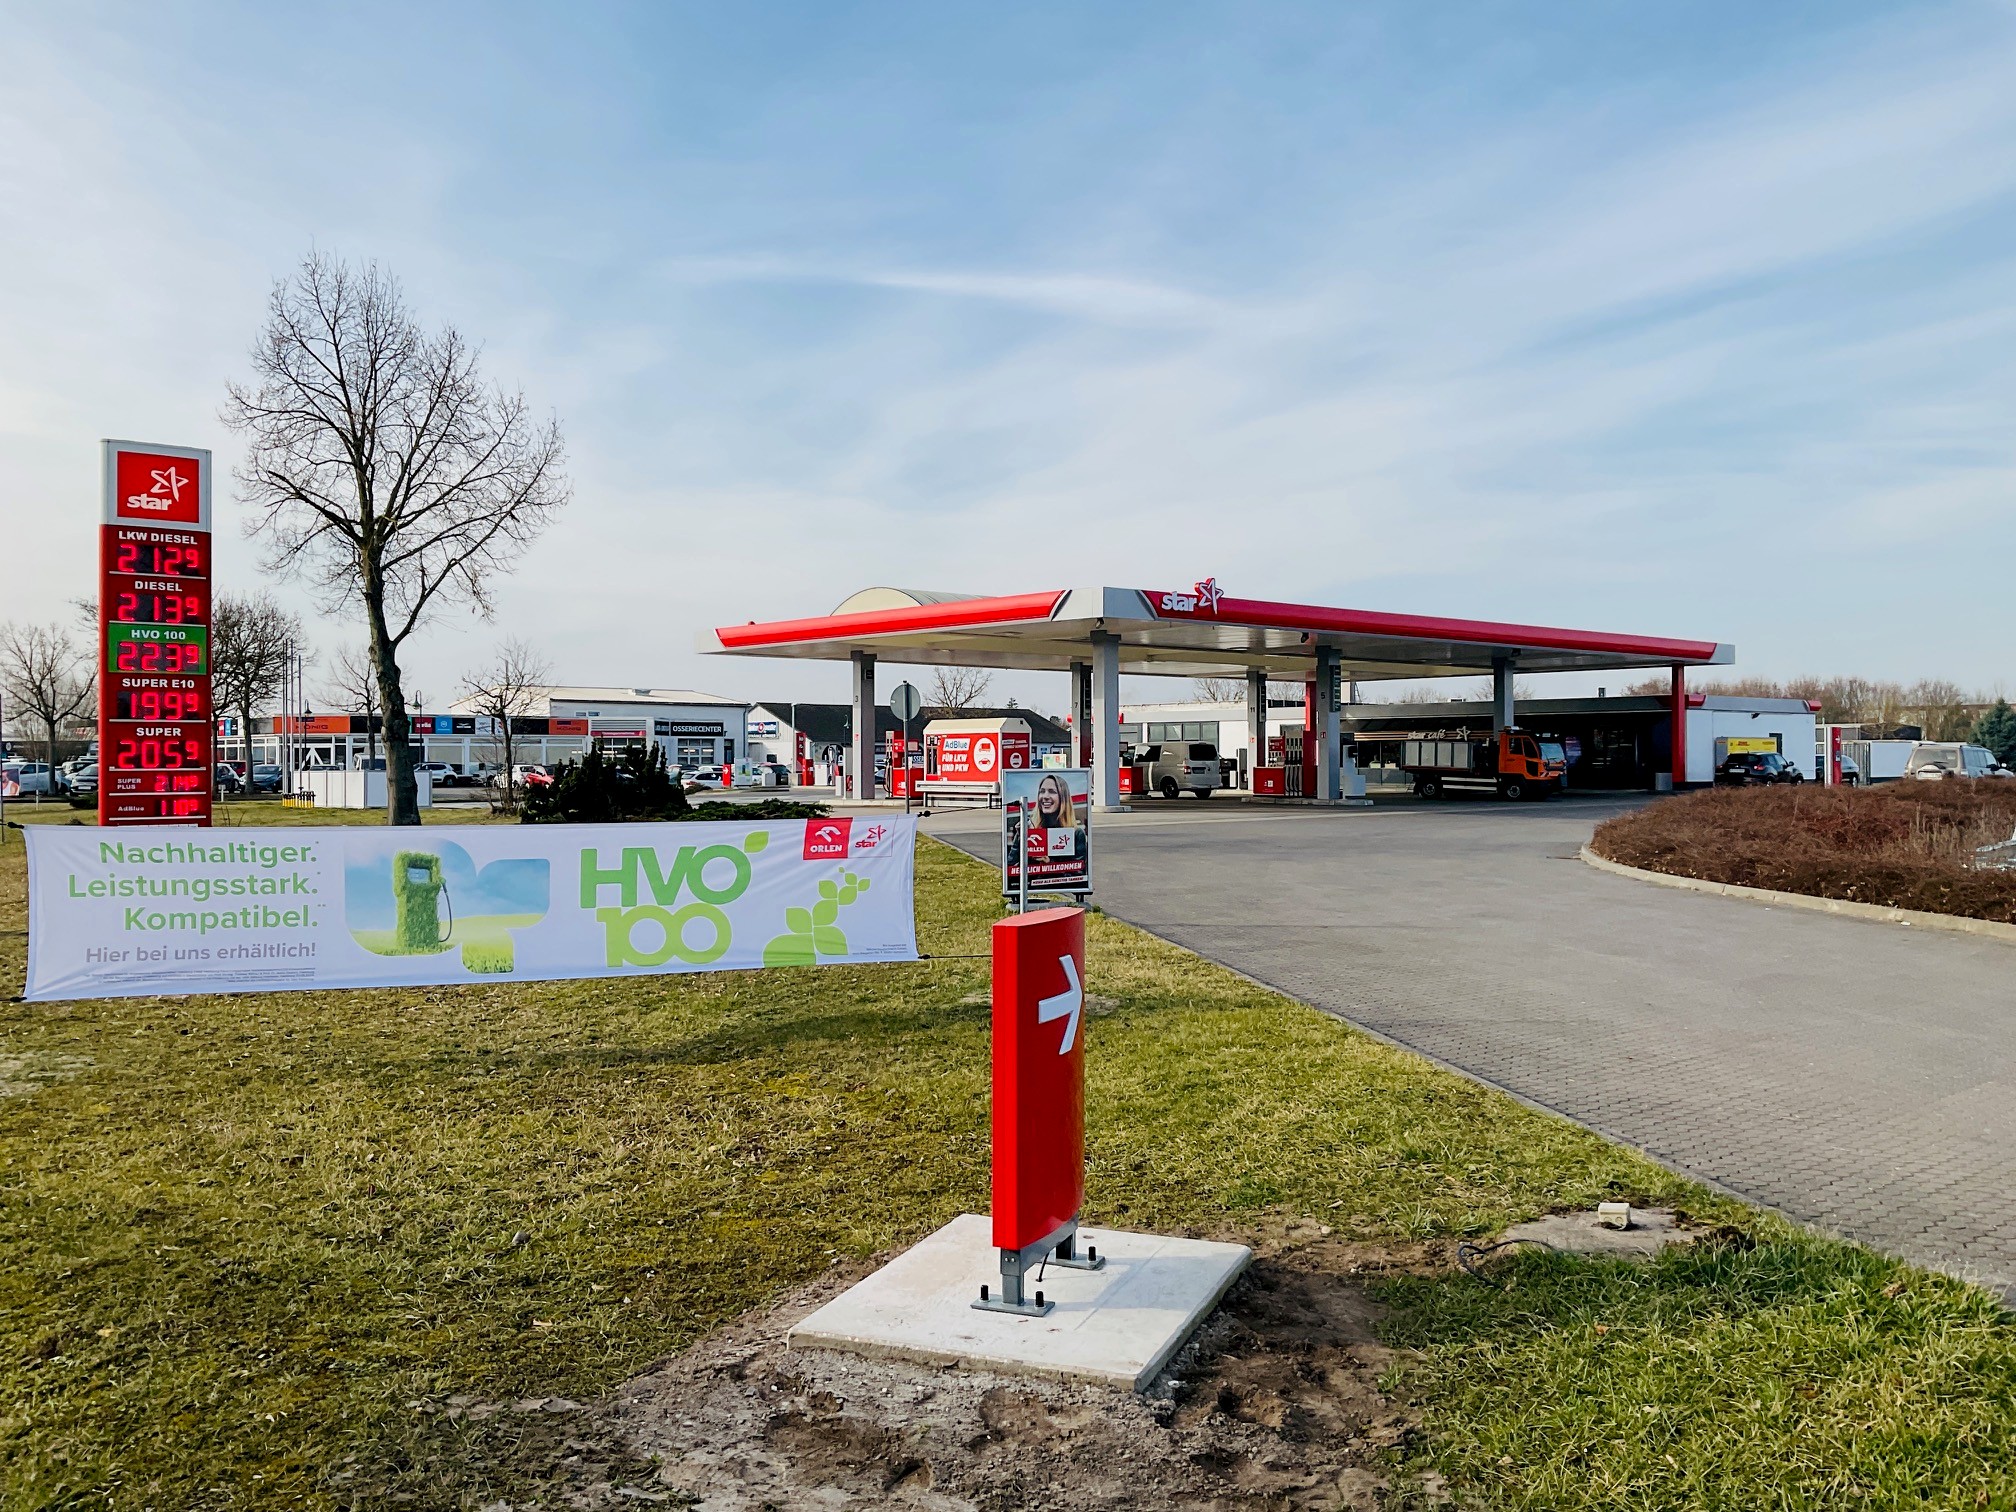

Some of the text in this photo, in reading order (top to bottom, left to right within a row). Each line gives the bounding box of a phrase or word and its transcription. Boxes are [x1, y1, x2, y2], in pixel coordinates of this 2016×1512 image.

[126, 493, 172, 511] star
[118, 530, 198, 545] LKW DIESEL
[134, 580, 182, 592] DIESEL
[1162, 591, 1197, 612] star
[131, 630, 186, 640] HVO 100
[122, 678, 194, 688] SUPER E10
[136, 727, 182, 736] SUPER
[944, 740, 968, 749] AdBlue
[942, 752, 968, 762] FÜR LKW
[942, 764, 969, 772] UND PKW
[810, 844, 843, 853] ORLEN
[855, 840, 877, 848] star
[100, 840, 317, 868] Nachhaltiger.
[1011, 862, 1082, 874] HELICH WILLKOMMEN
[580, 844, 752, 908] HVO
[68, 872, 318, 902] Leistungsstark.
[124, 904, 318, 935] Kompatibel.
[596, 902, 733, 968] 100
[86, 942, 316, 962] Hier bei uns erhältlich!
